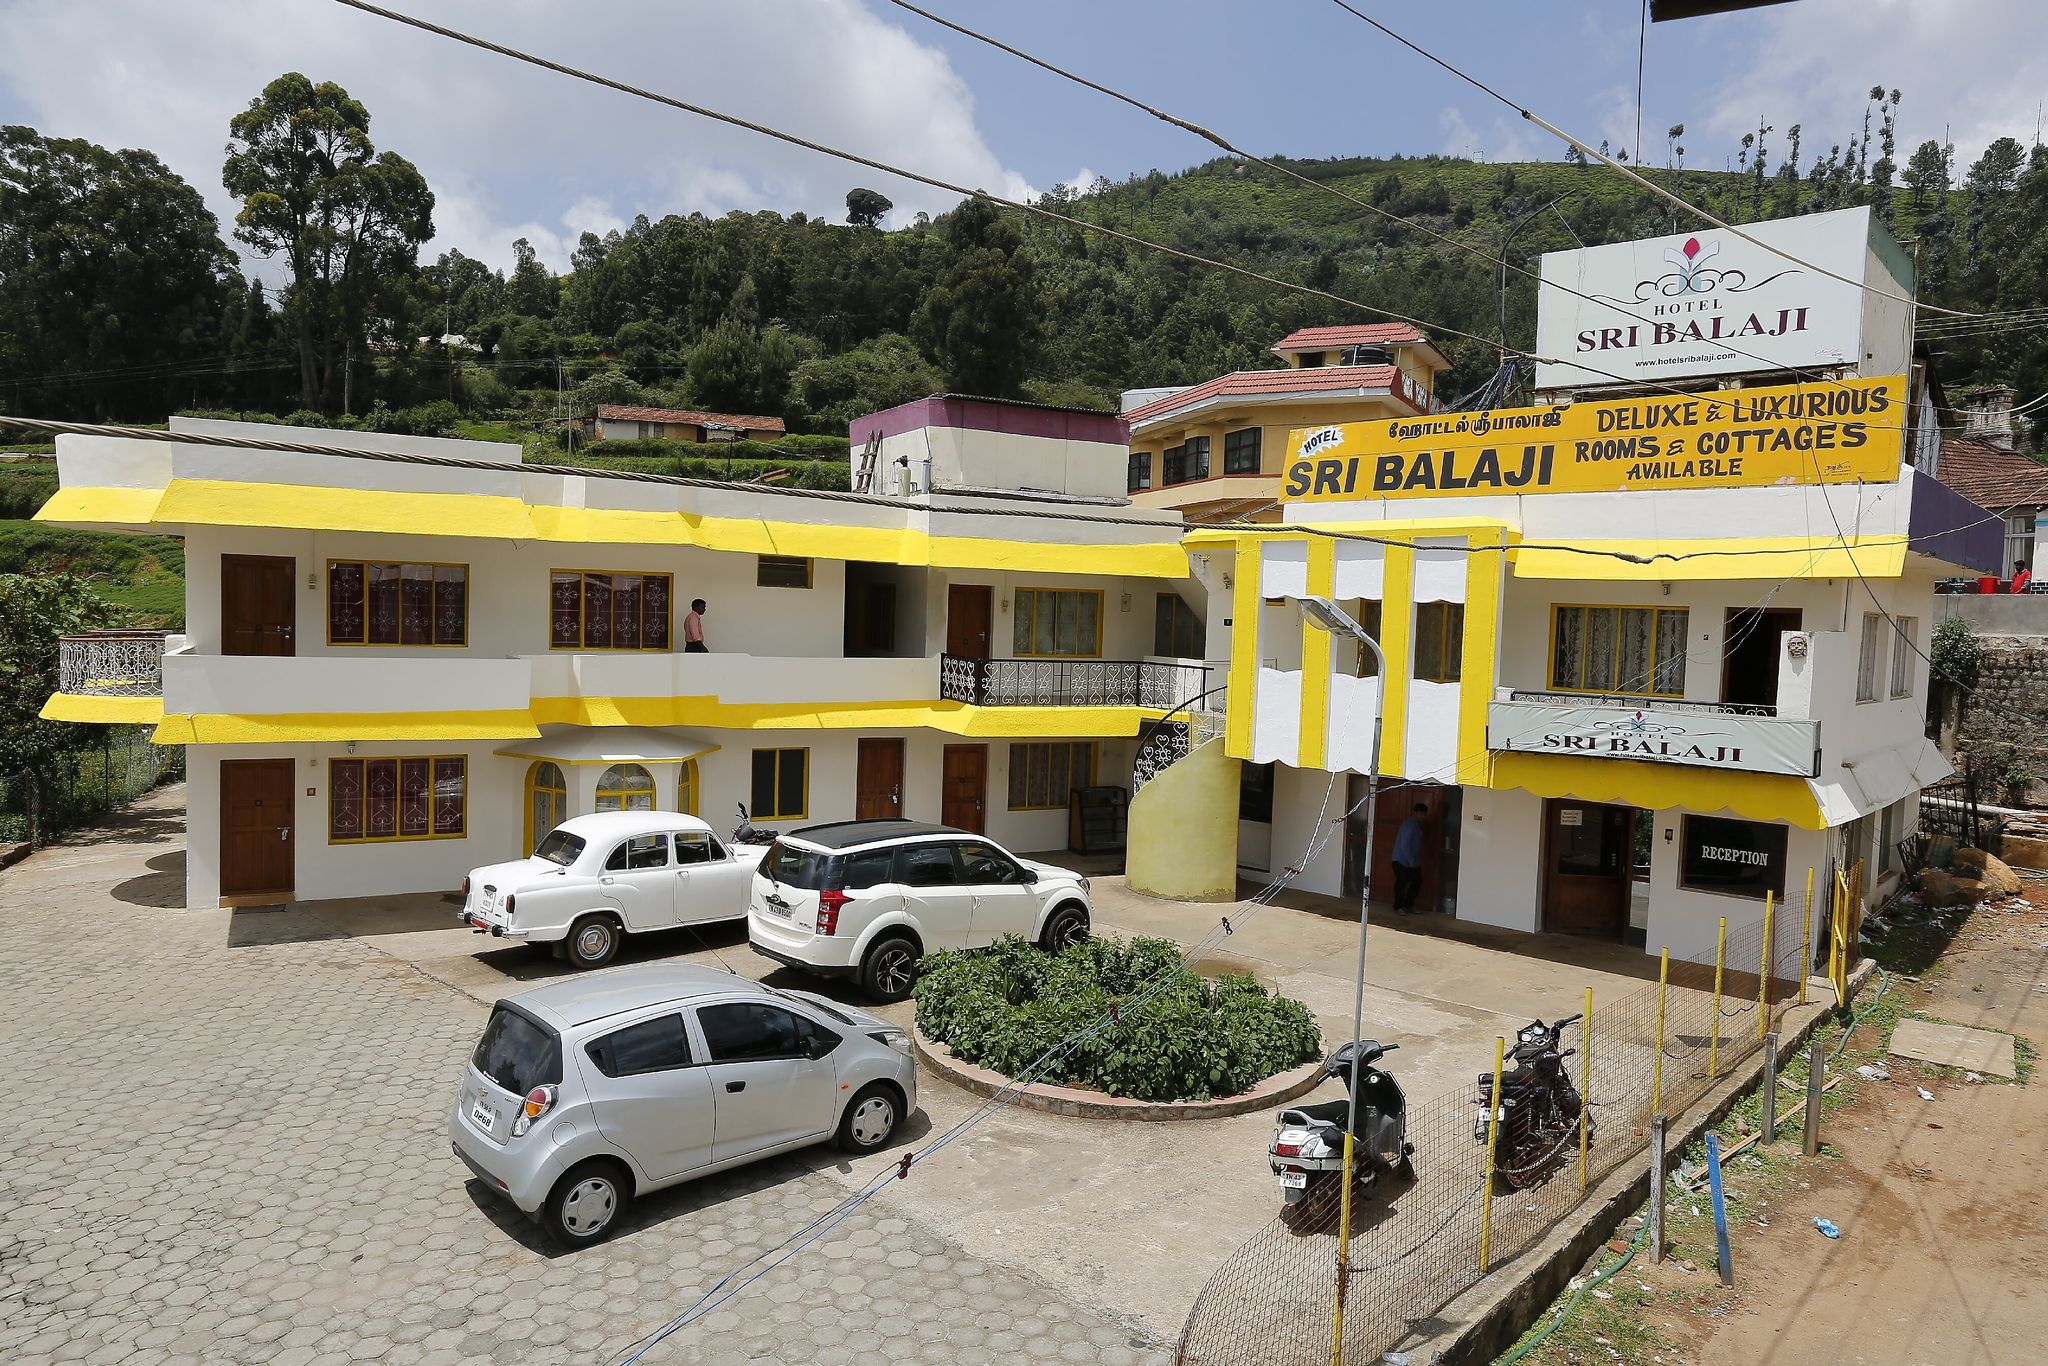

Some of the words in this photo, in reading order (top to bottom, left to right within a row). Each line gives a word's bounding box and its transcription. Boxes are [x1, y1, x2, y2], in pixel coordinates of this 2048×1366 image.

[1654, 299, 1723, 316] HOTEL
[1576, 325, 1641, 353] SRI
[1650, 307, 1810, 346] BALAJI
[1635, 351, 1736, 368] www.hotelsribalaji.com
[1596, 402, 1699, 432] DELUXE
[1706, 403, 1726, 422] &
[1733, 387, 1889, 424] LUXURIOUS
[1303, 430, 1338, 453] HOTEL
[1575, 436, 1660, 464] ROOMS
[1666, 440, 1684, 456] &
[1697, 423, 1867, 455] COTTAGES
[1286, 458, 1360, 496] SRI
[1373, 445, 1555, 491] BALAJI
[1626, 458, 1743, 480] AVAILABLE
[1610, 731, 1668, 740] HOTEL
[1543, 733, 1597, 750] SRI
[1610, 738, 1743, 762] BALAJI
[1702, 845, 1769, 867] RECEPTION
[473, 1109, 492, 1127] 0268
